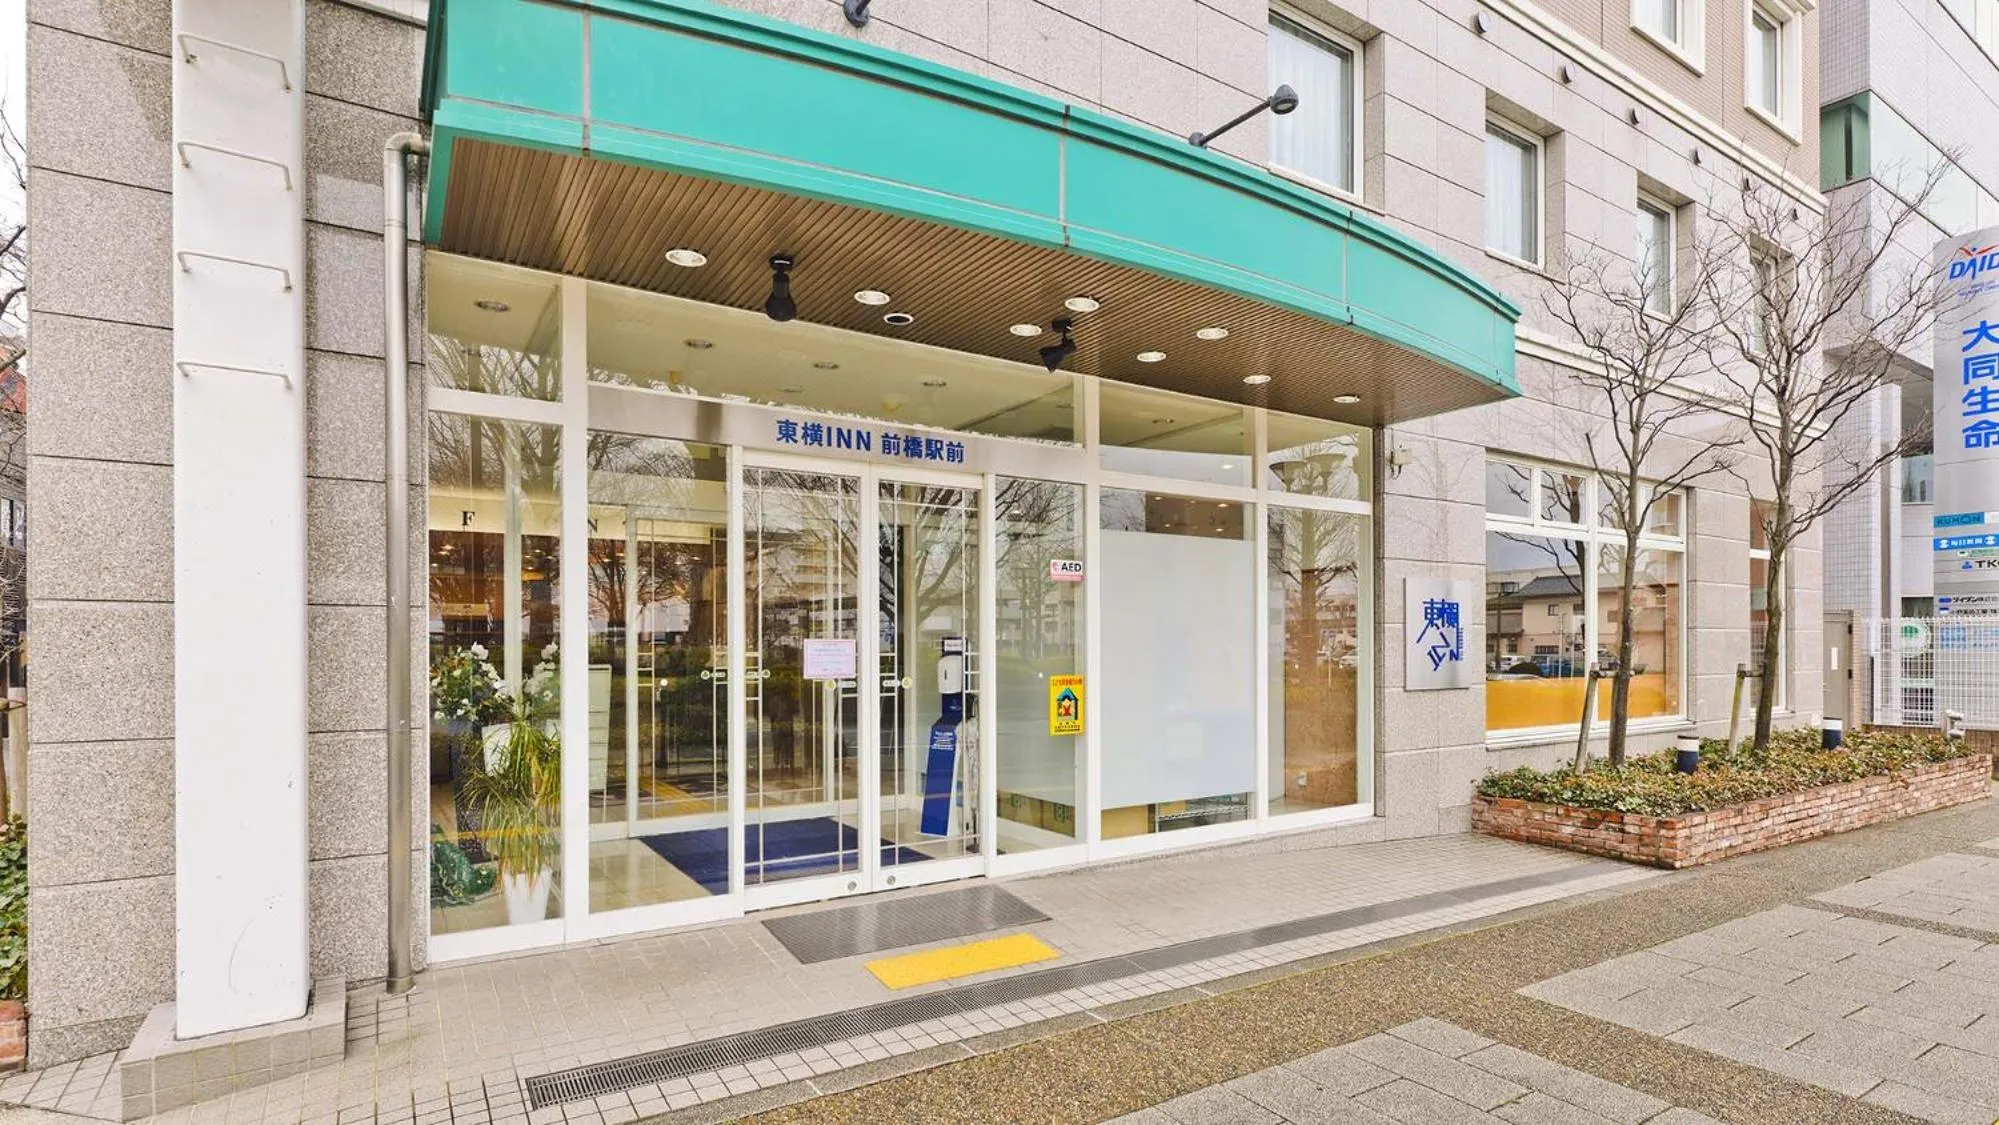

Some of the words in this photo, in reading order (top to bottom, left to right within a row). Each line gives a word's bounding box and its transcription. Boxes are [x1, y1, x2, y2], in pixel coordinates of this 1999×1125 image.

[1962, 319, 1999, 449] 大同生命
[777, 419, 871, 452] 東横INN
[881, 433, 965, 463] 前橋駅前
[1937, 514, 1981, 525] KUMON
[1062, 562, 1082, 572] AED
[1976, 560, 1999, 568] TK
